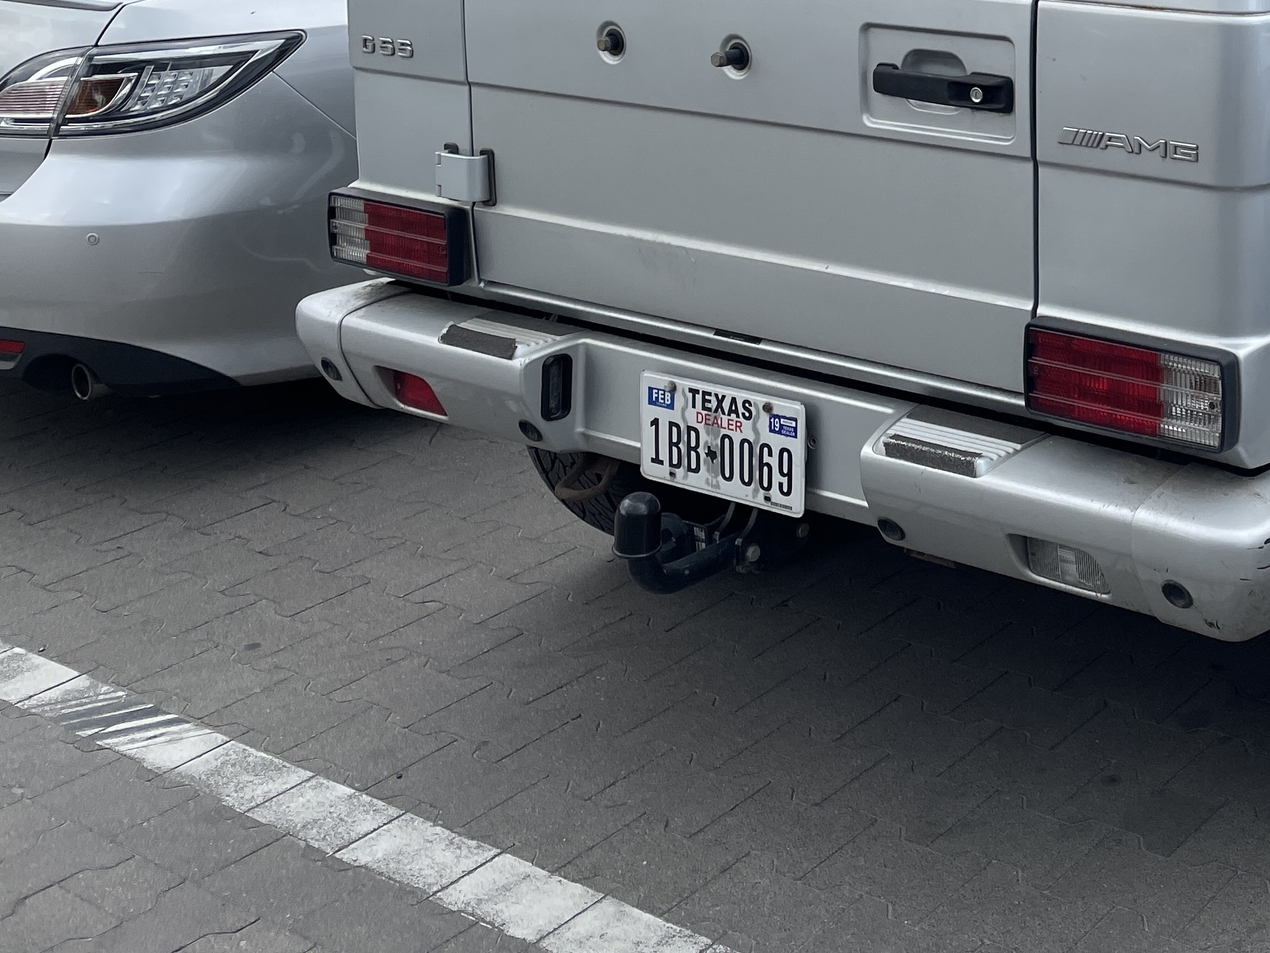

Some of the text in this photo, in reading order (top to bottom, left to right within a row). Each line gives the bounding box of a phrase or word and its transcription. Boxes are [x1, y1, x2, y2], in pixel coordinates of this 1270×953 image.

[1100, 131, 1199, 163] AMG
[652, 389, 672, 404] FEB
[688, 388, 754, 421] TEXAS
[695, 411, 743, 434] DEALER
[770, 417, 780, 431] 19
[649, 417, 793, 498] 1BB 0069
